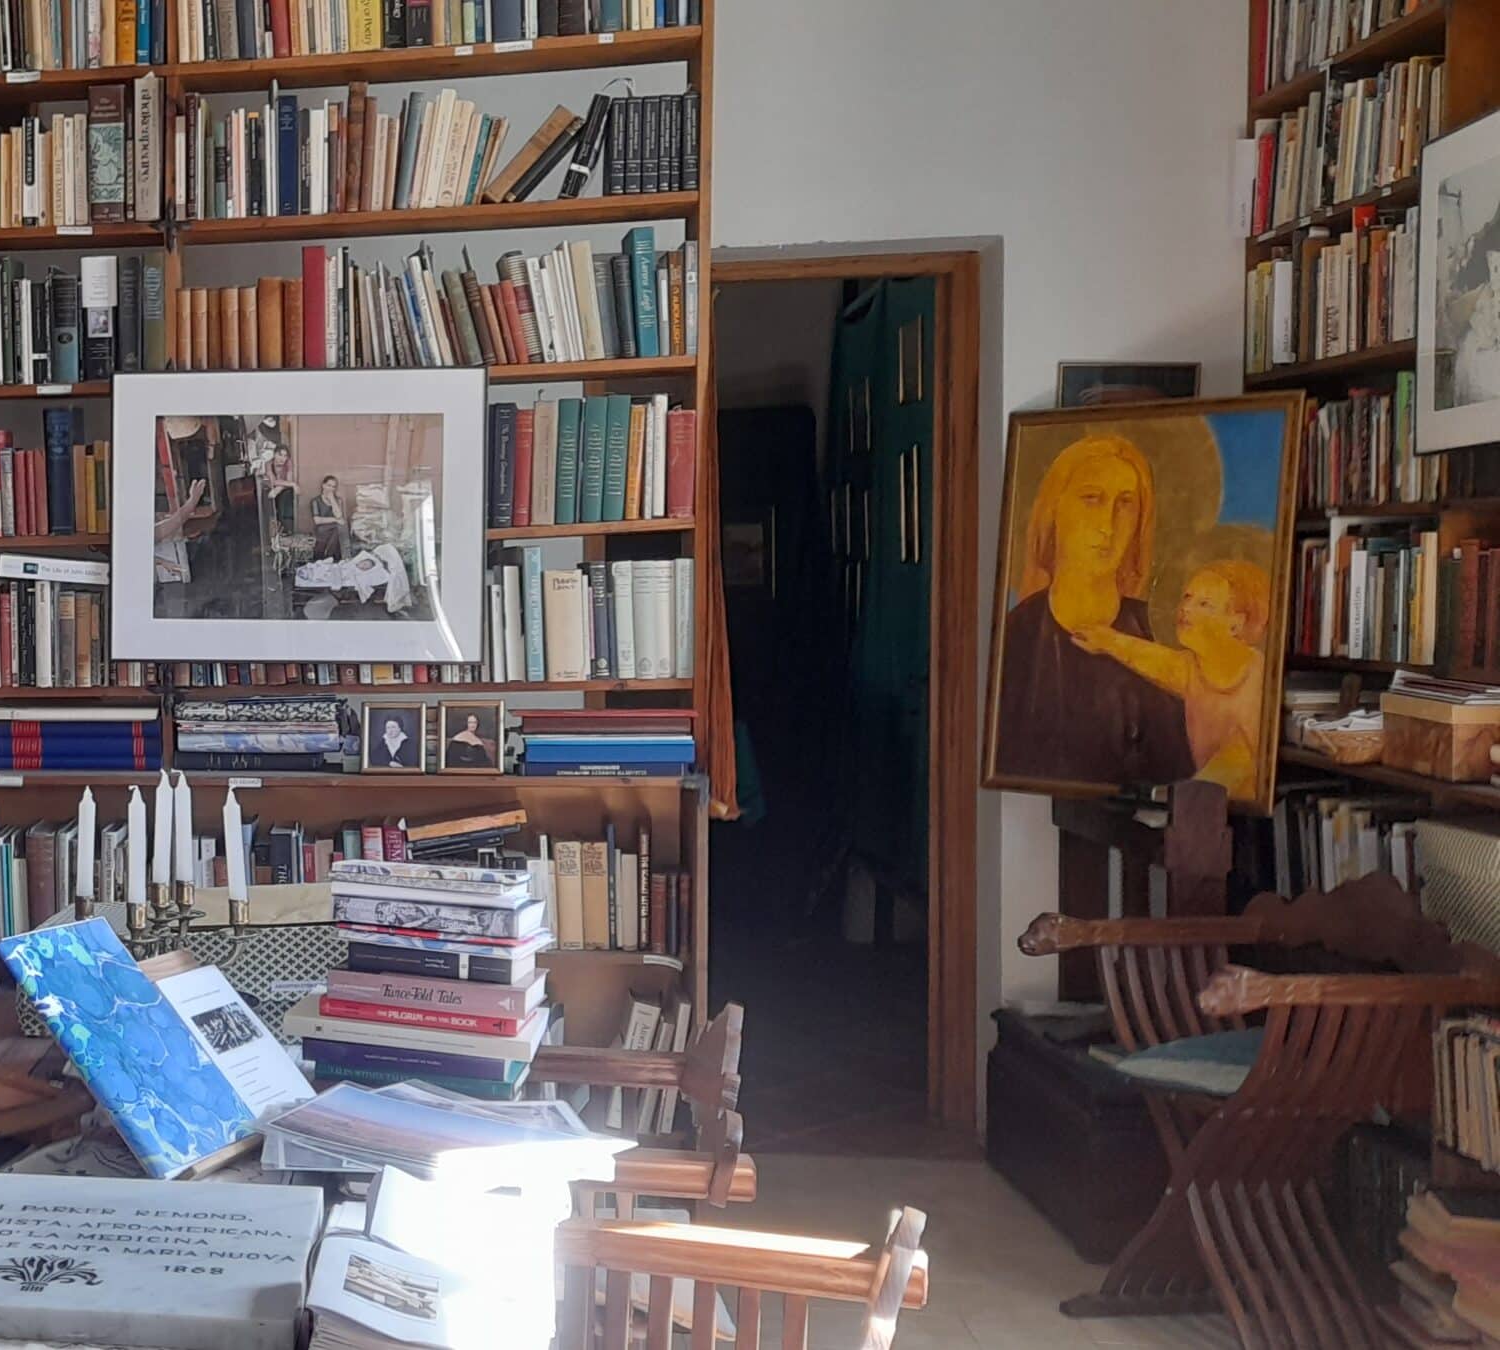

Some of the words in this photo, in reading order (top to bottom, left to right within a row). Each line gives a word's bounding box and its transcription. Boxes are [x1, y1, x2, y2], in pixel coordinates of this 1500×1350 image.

[382, 983, 434, 1002] Twice-Told
[436, 989, 463, 1006] Tales
[387, 1010, 423, 1022] PILGRIM
[450, 1016, 478, 1027] BOOK
[20, 1204, 117, 1216] PARKER
[28, 1231, 60, 1239] LA
[76, 1232, 210, 1246] MEDICINA
[29, 1242, 111, 1253] SANTA
[122, 1246, 199, 1258] MARIA
[208, 1251, 297, 1263] NUOVA
[162, 1264, 225, 1276] 1868
